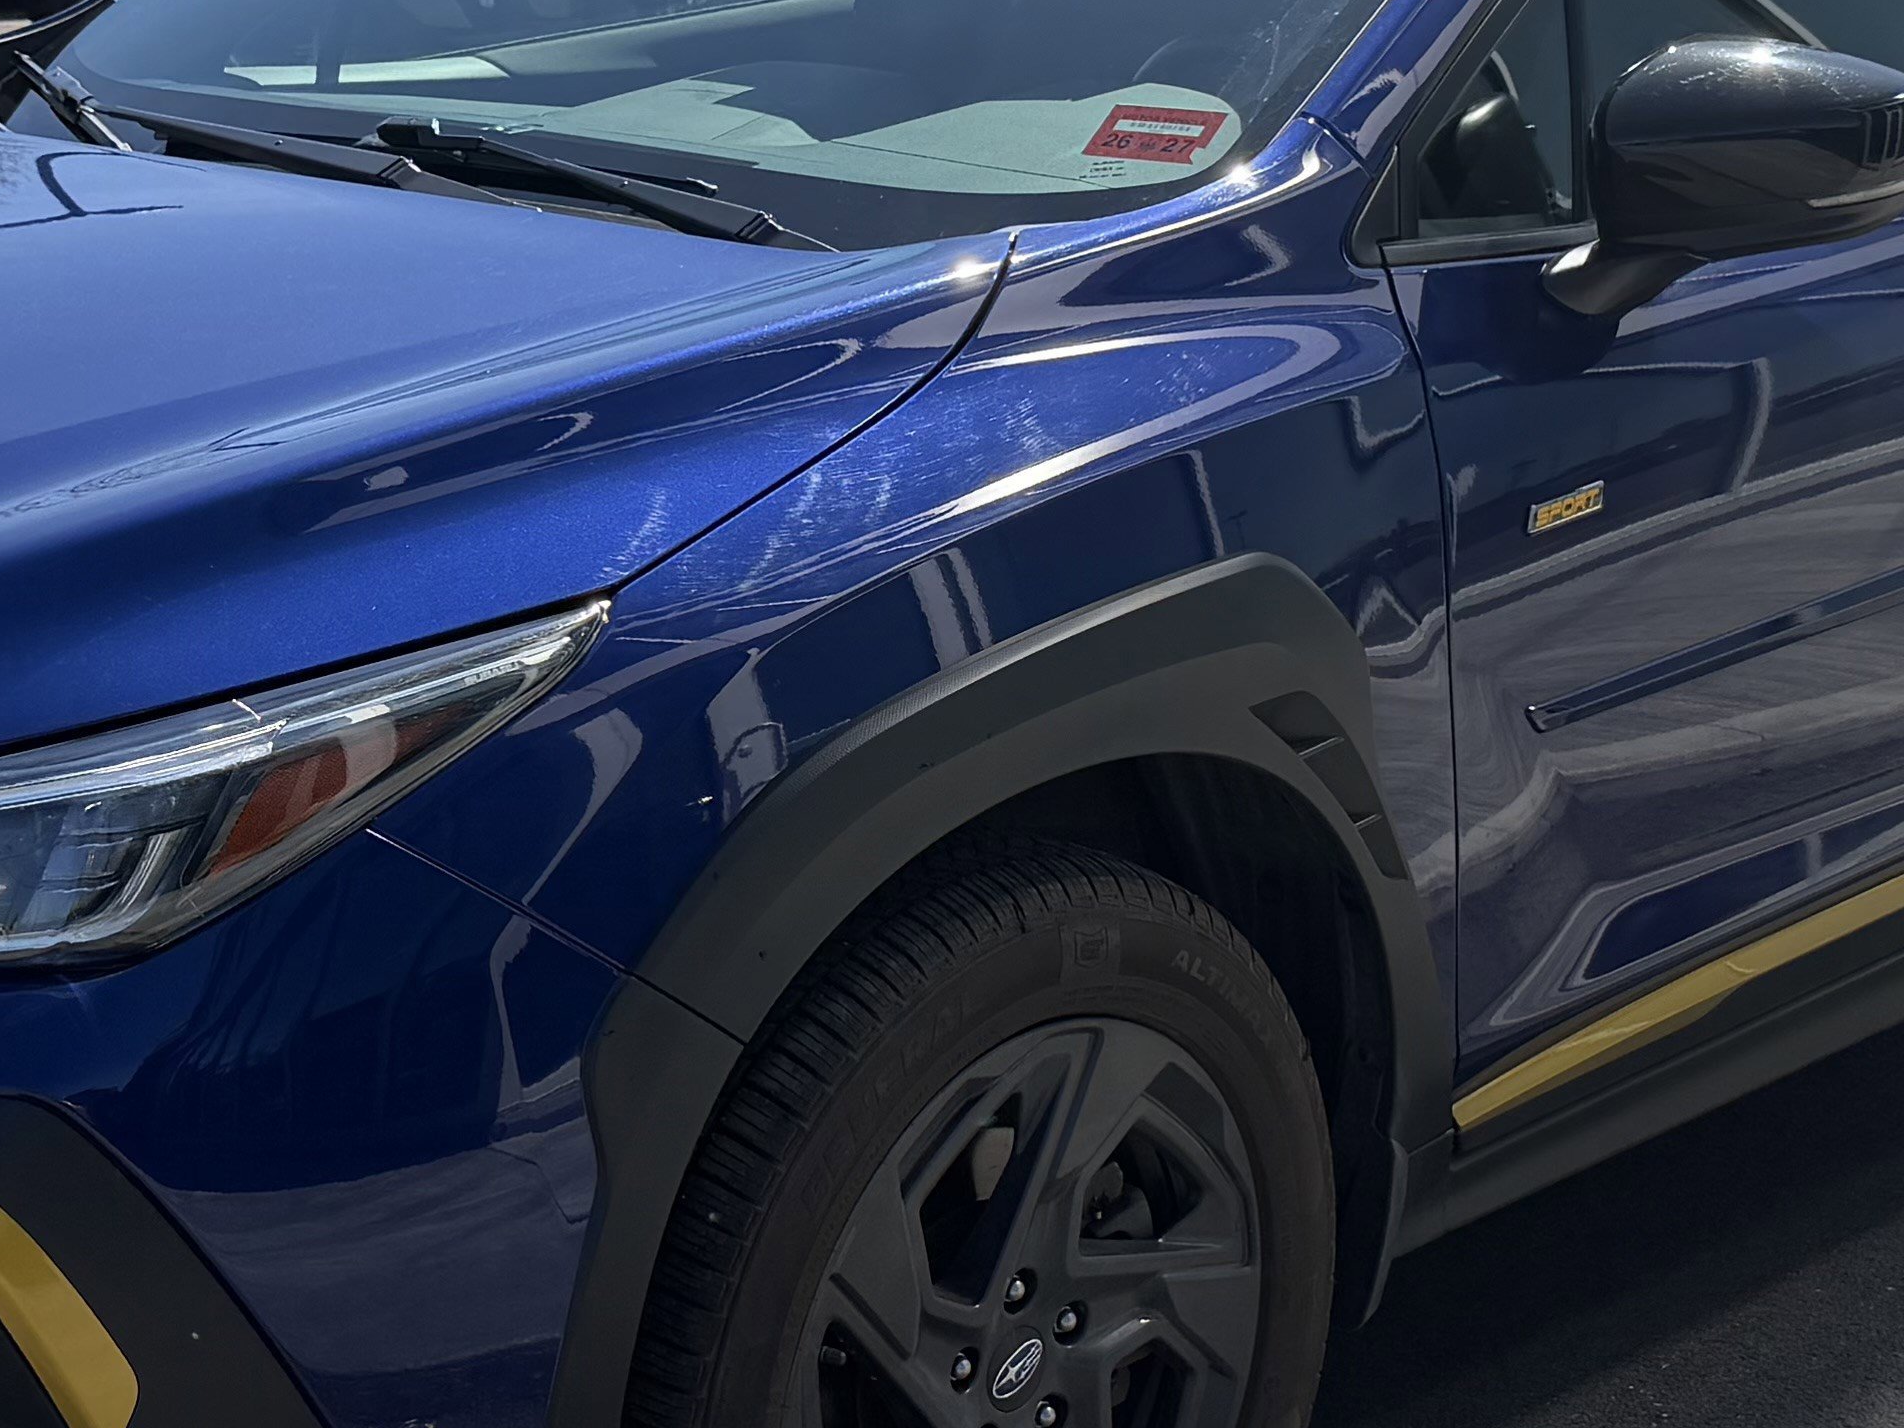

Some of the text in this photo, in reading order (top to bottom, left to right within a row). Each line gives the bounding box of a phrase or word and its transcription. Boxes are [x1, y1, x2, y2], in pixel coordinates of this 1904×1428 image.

[1101, 133, 1133, 149] 26
[1160, 137, 1196, 153] 27
[1536, 488, 1600, 528] SPORT
